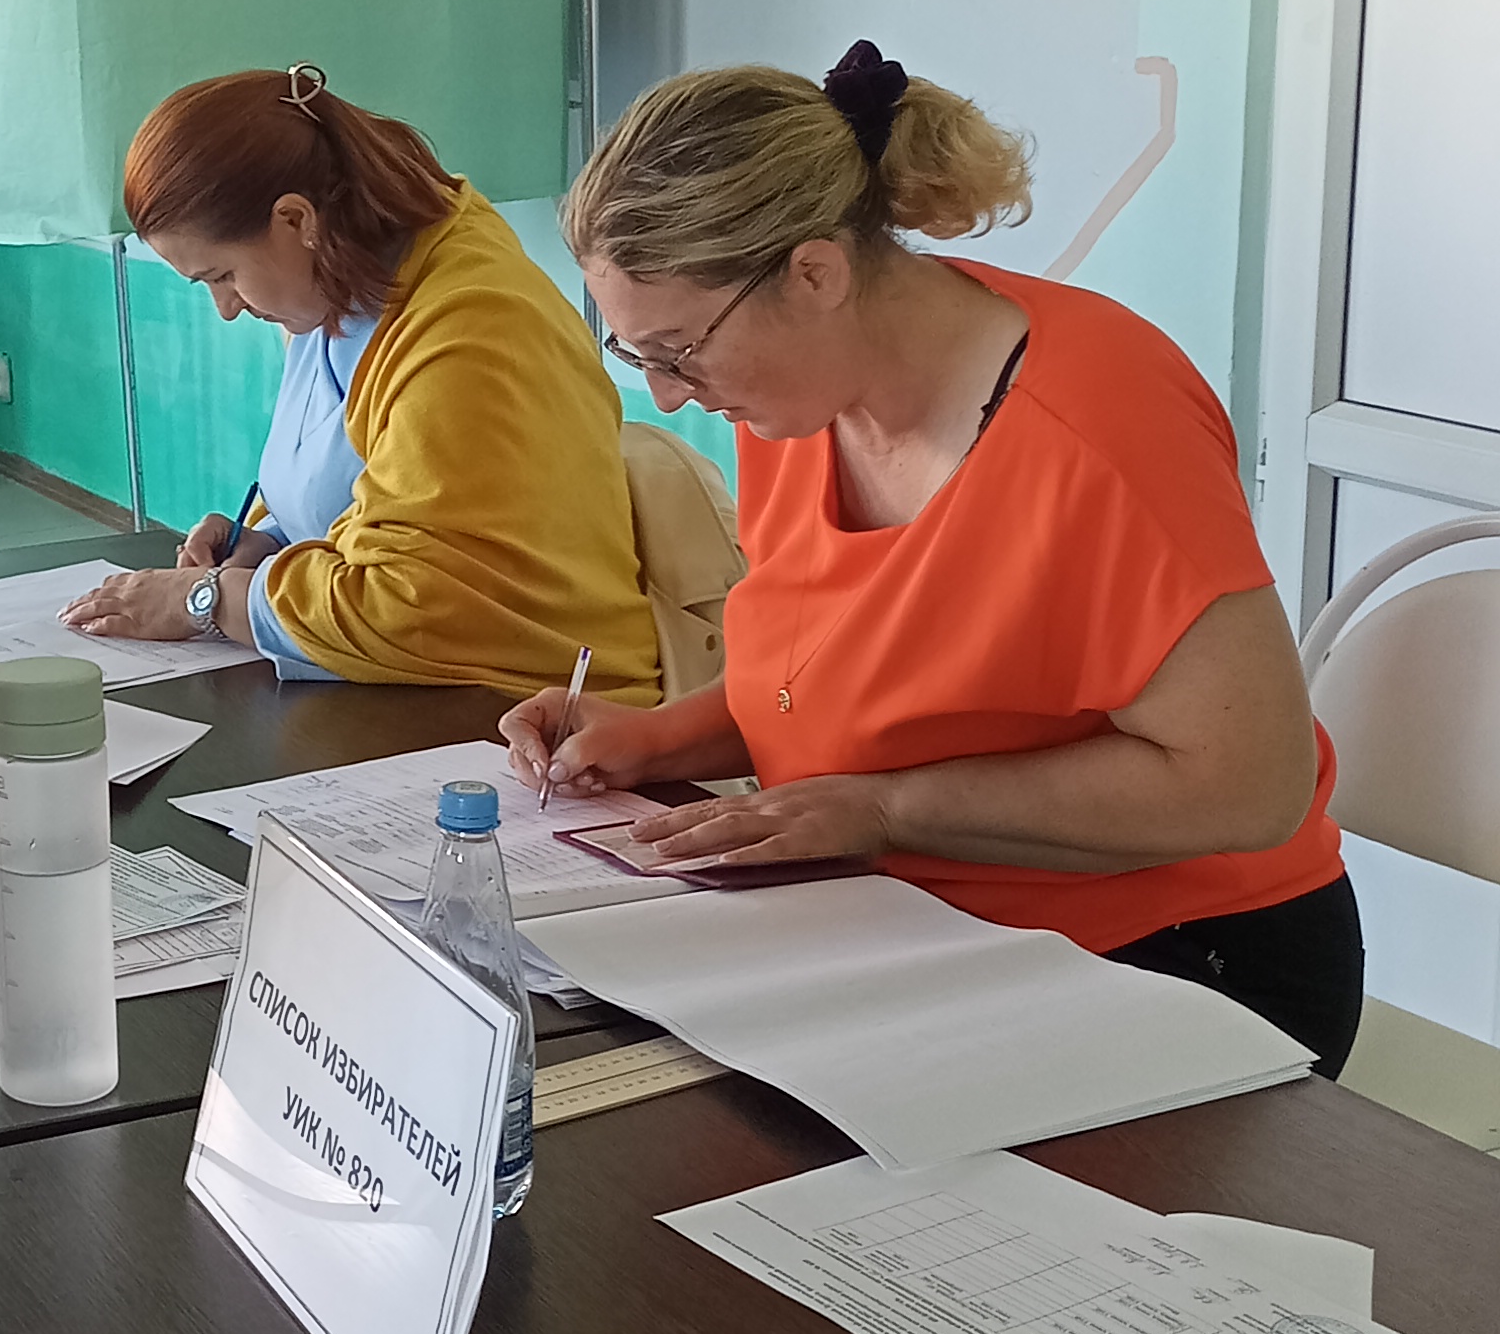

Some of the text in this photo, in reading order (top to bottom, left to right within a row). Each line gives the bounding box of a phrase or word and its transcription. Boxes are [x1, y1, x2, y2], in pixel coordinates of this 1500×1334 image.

[249, 971, 321, 1060] СПИСОК
[322, 1036, 462, 1197] ИЗБИРАТЕЛЕЙ
[282, 1085, 384, 1213] УИК № 820
